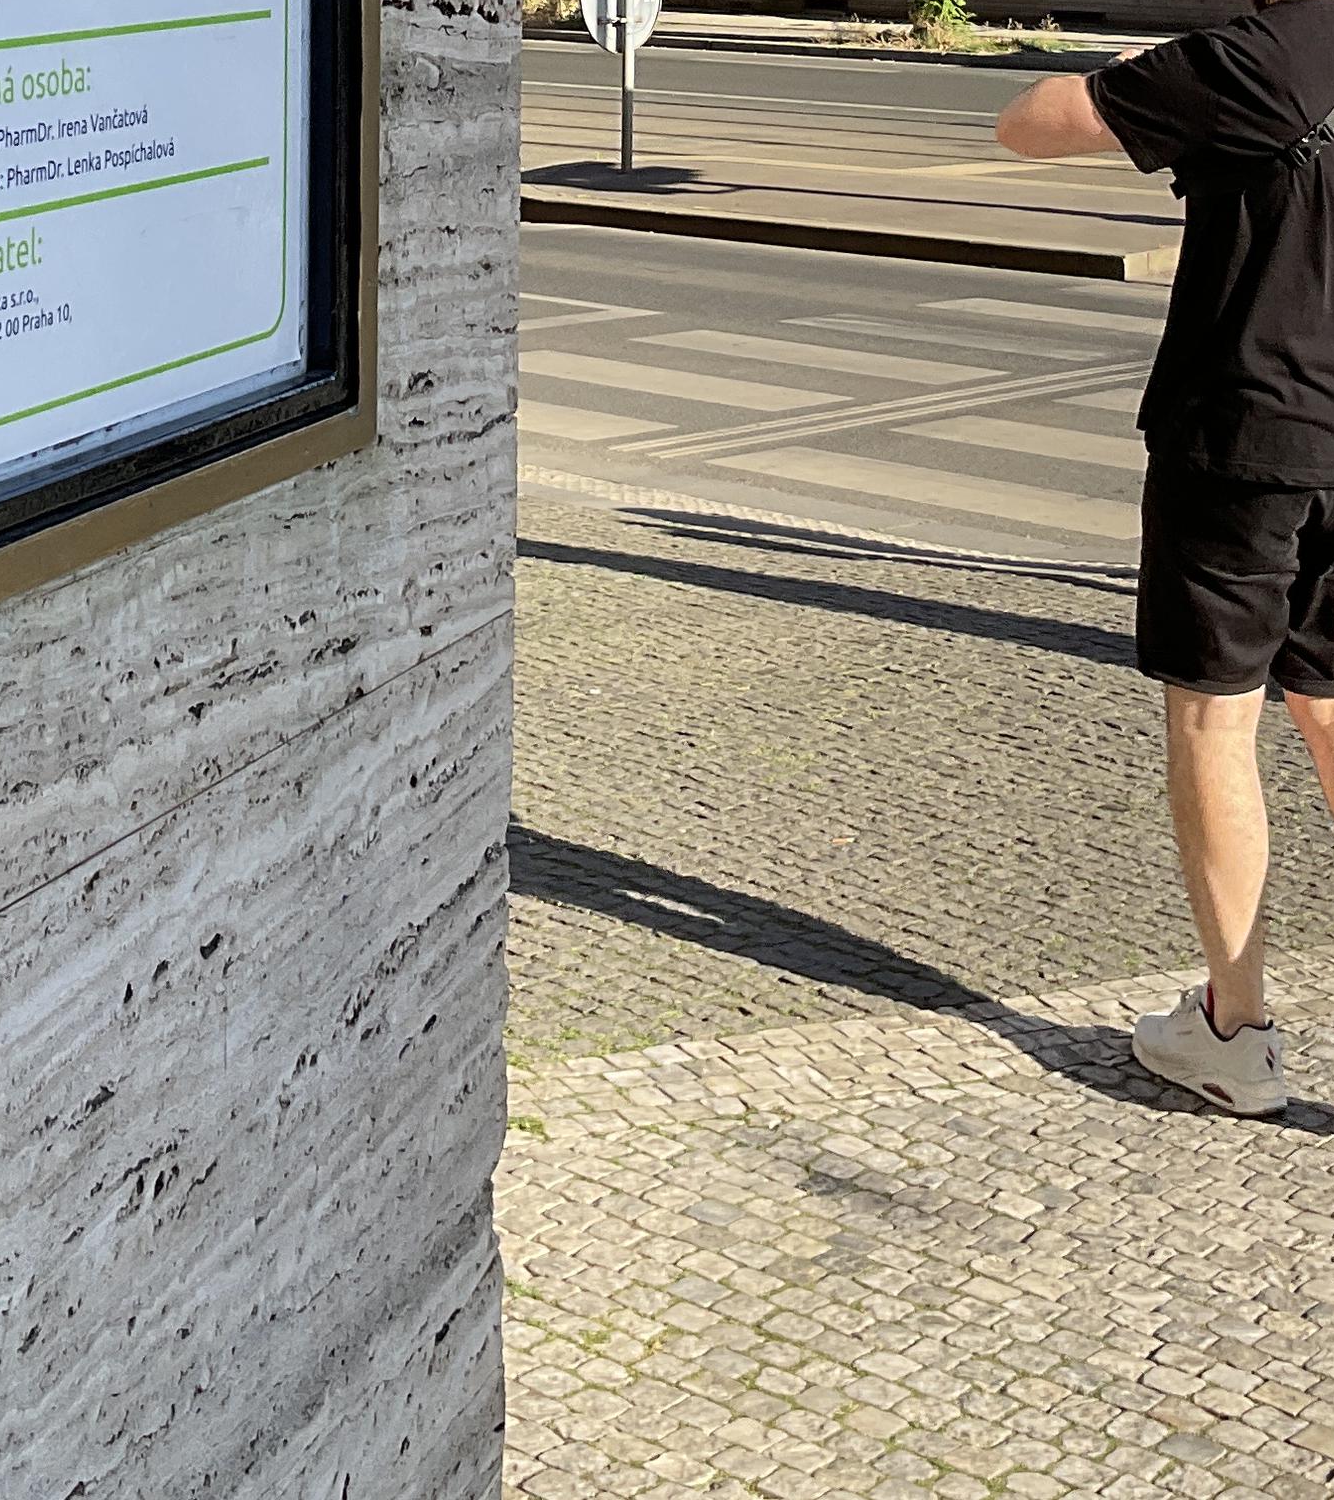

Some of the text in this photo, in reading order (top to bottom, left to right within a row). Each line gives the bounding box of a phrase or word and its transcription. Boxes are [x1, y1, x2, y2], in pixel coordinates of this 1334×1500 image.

[22, 58, 92, 100] osoba:
[57, 118, 88, 139] Irena
[90, 104, 149, 133] Vančatová
[6, 160, 65, 189] PharmDr.
[67, 151, 102, 177] Lenka
[104, 137, 175, 171] Pospíchalová
[5, 316, 21, 338] 00
[22, 307, 55, 333] Praha
[56, 302, 73, 324] 10,
